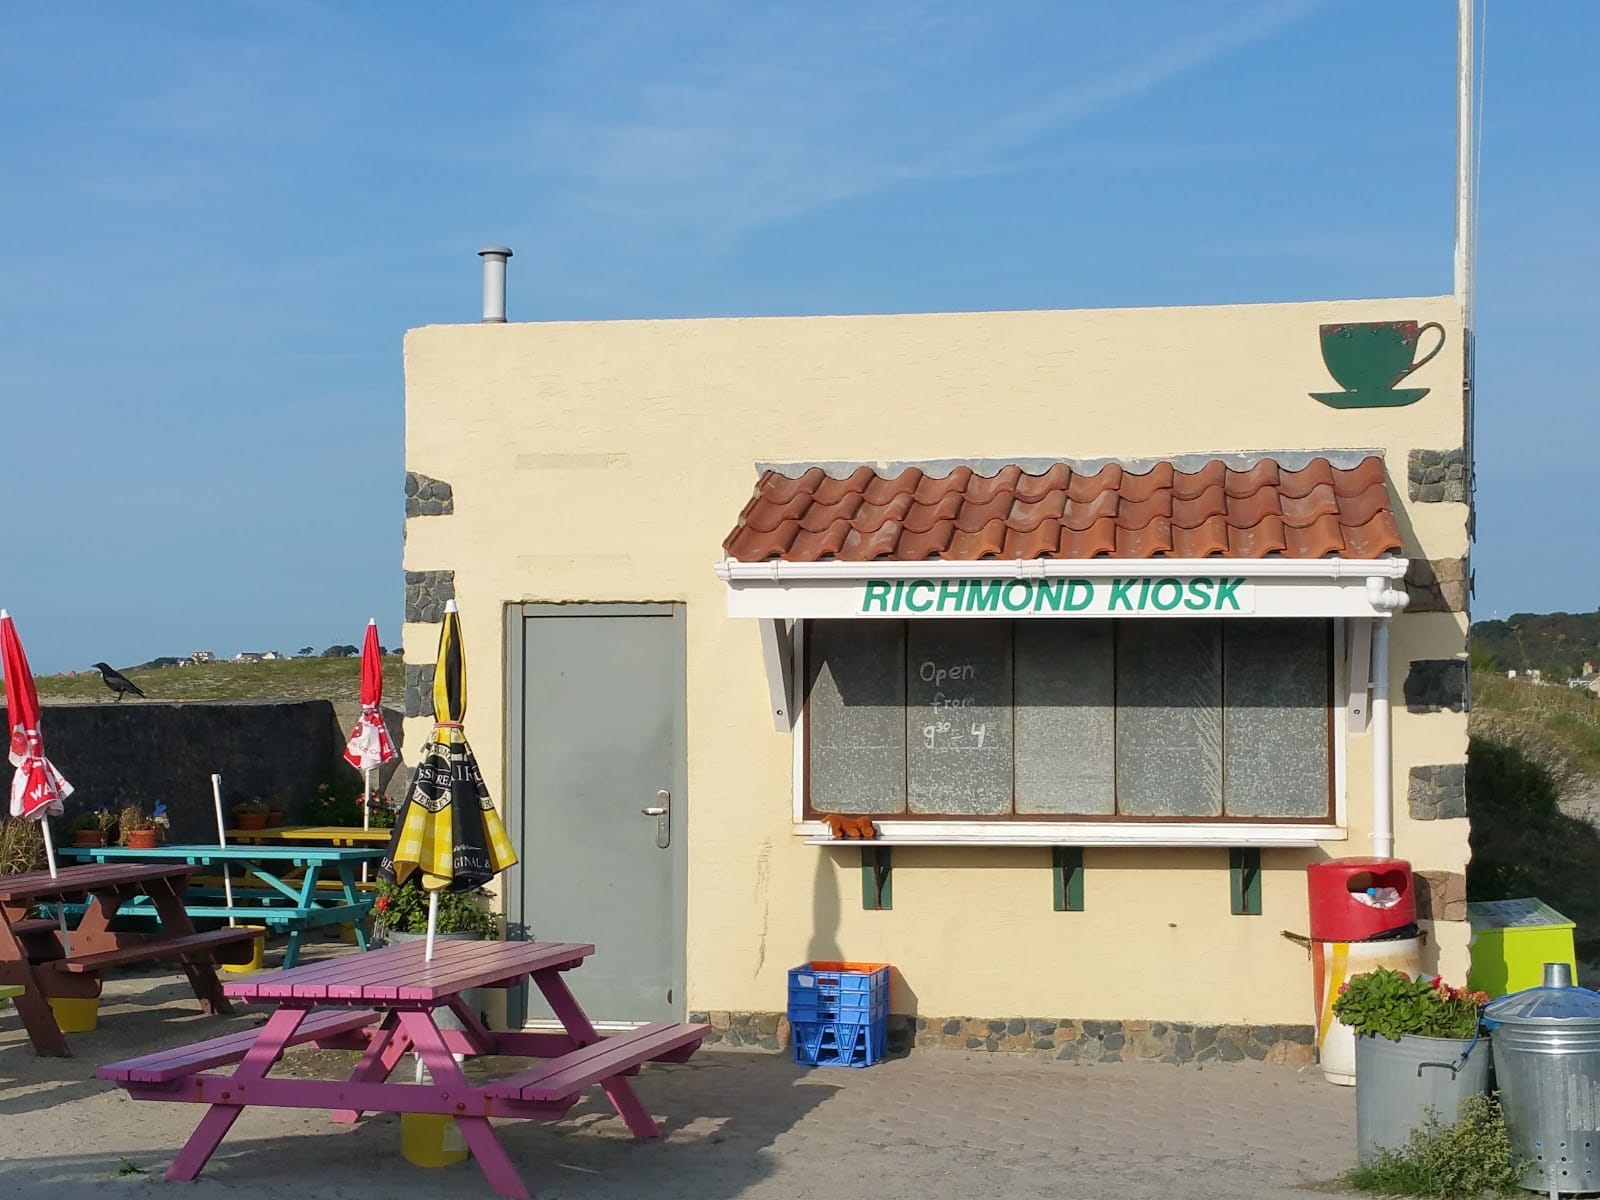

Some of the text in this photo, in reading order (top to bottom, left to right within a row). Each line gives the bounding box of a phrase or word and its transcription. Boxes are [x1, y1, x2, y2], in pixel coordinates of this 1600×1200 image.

[861, 577, 1246, 612] RICHMOND KIOSK
[920, 661, 975, 687] Open
